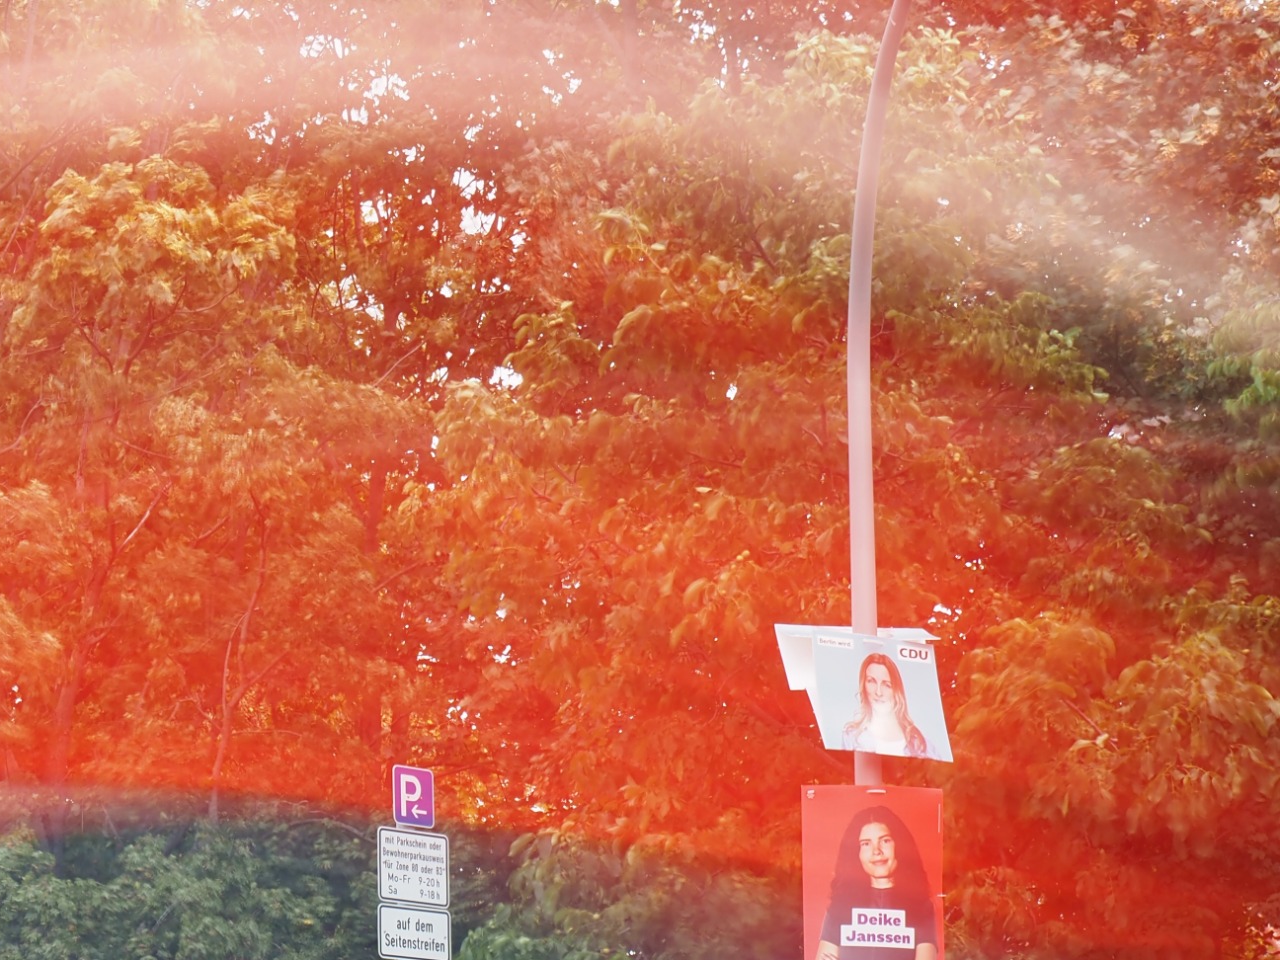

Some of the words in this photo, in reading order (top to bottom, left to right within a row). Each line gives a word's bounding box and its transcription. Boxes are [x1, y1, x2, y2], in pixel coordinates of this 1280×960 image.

[899, 648, 929, 661] CDU
[400, 773, 422, 817] P
[384, 836, 395, 845] mit
[396, 836, 427, 849] Parkschein
[429, 842, 442, 851] oder
[382, 846, 444, 864] Bewohnerparkausweis
[384, 860, 393, 869] für
[396, 861, 410, 872] Zone
[420, 865, 434, 875] oder
[387, 873, 411, 884] Mo-Fr
[418, 877, 435, 887] 9-20
[388, 885, 398, 895] Sa
[419, 889, 435, 900] 9-18
[396, 917, 411, 931] auf
[415, 918, 434, 933] dem
[857, 913, 902, 927] Deike
[384, 932, 446, 953] Seitenstreifen
[846, 930, 911, 944] Janssen
